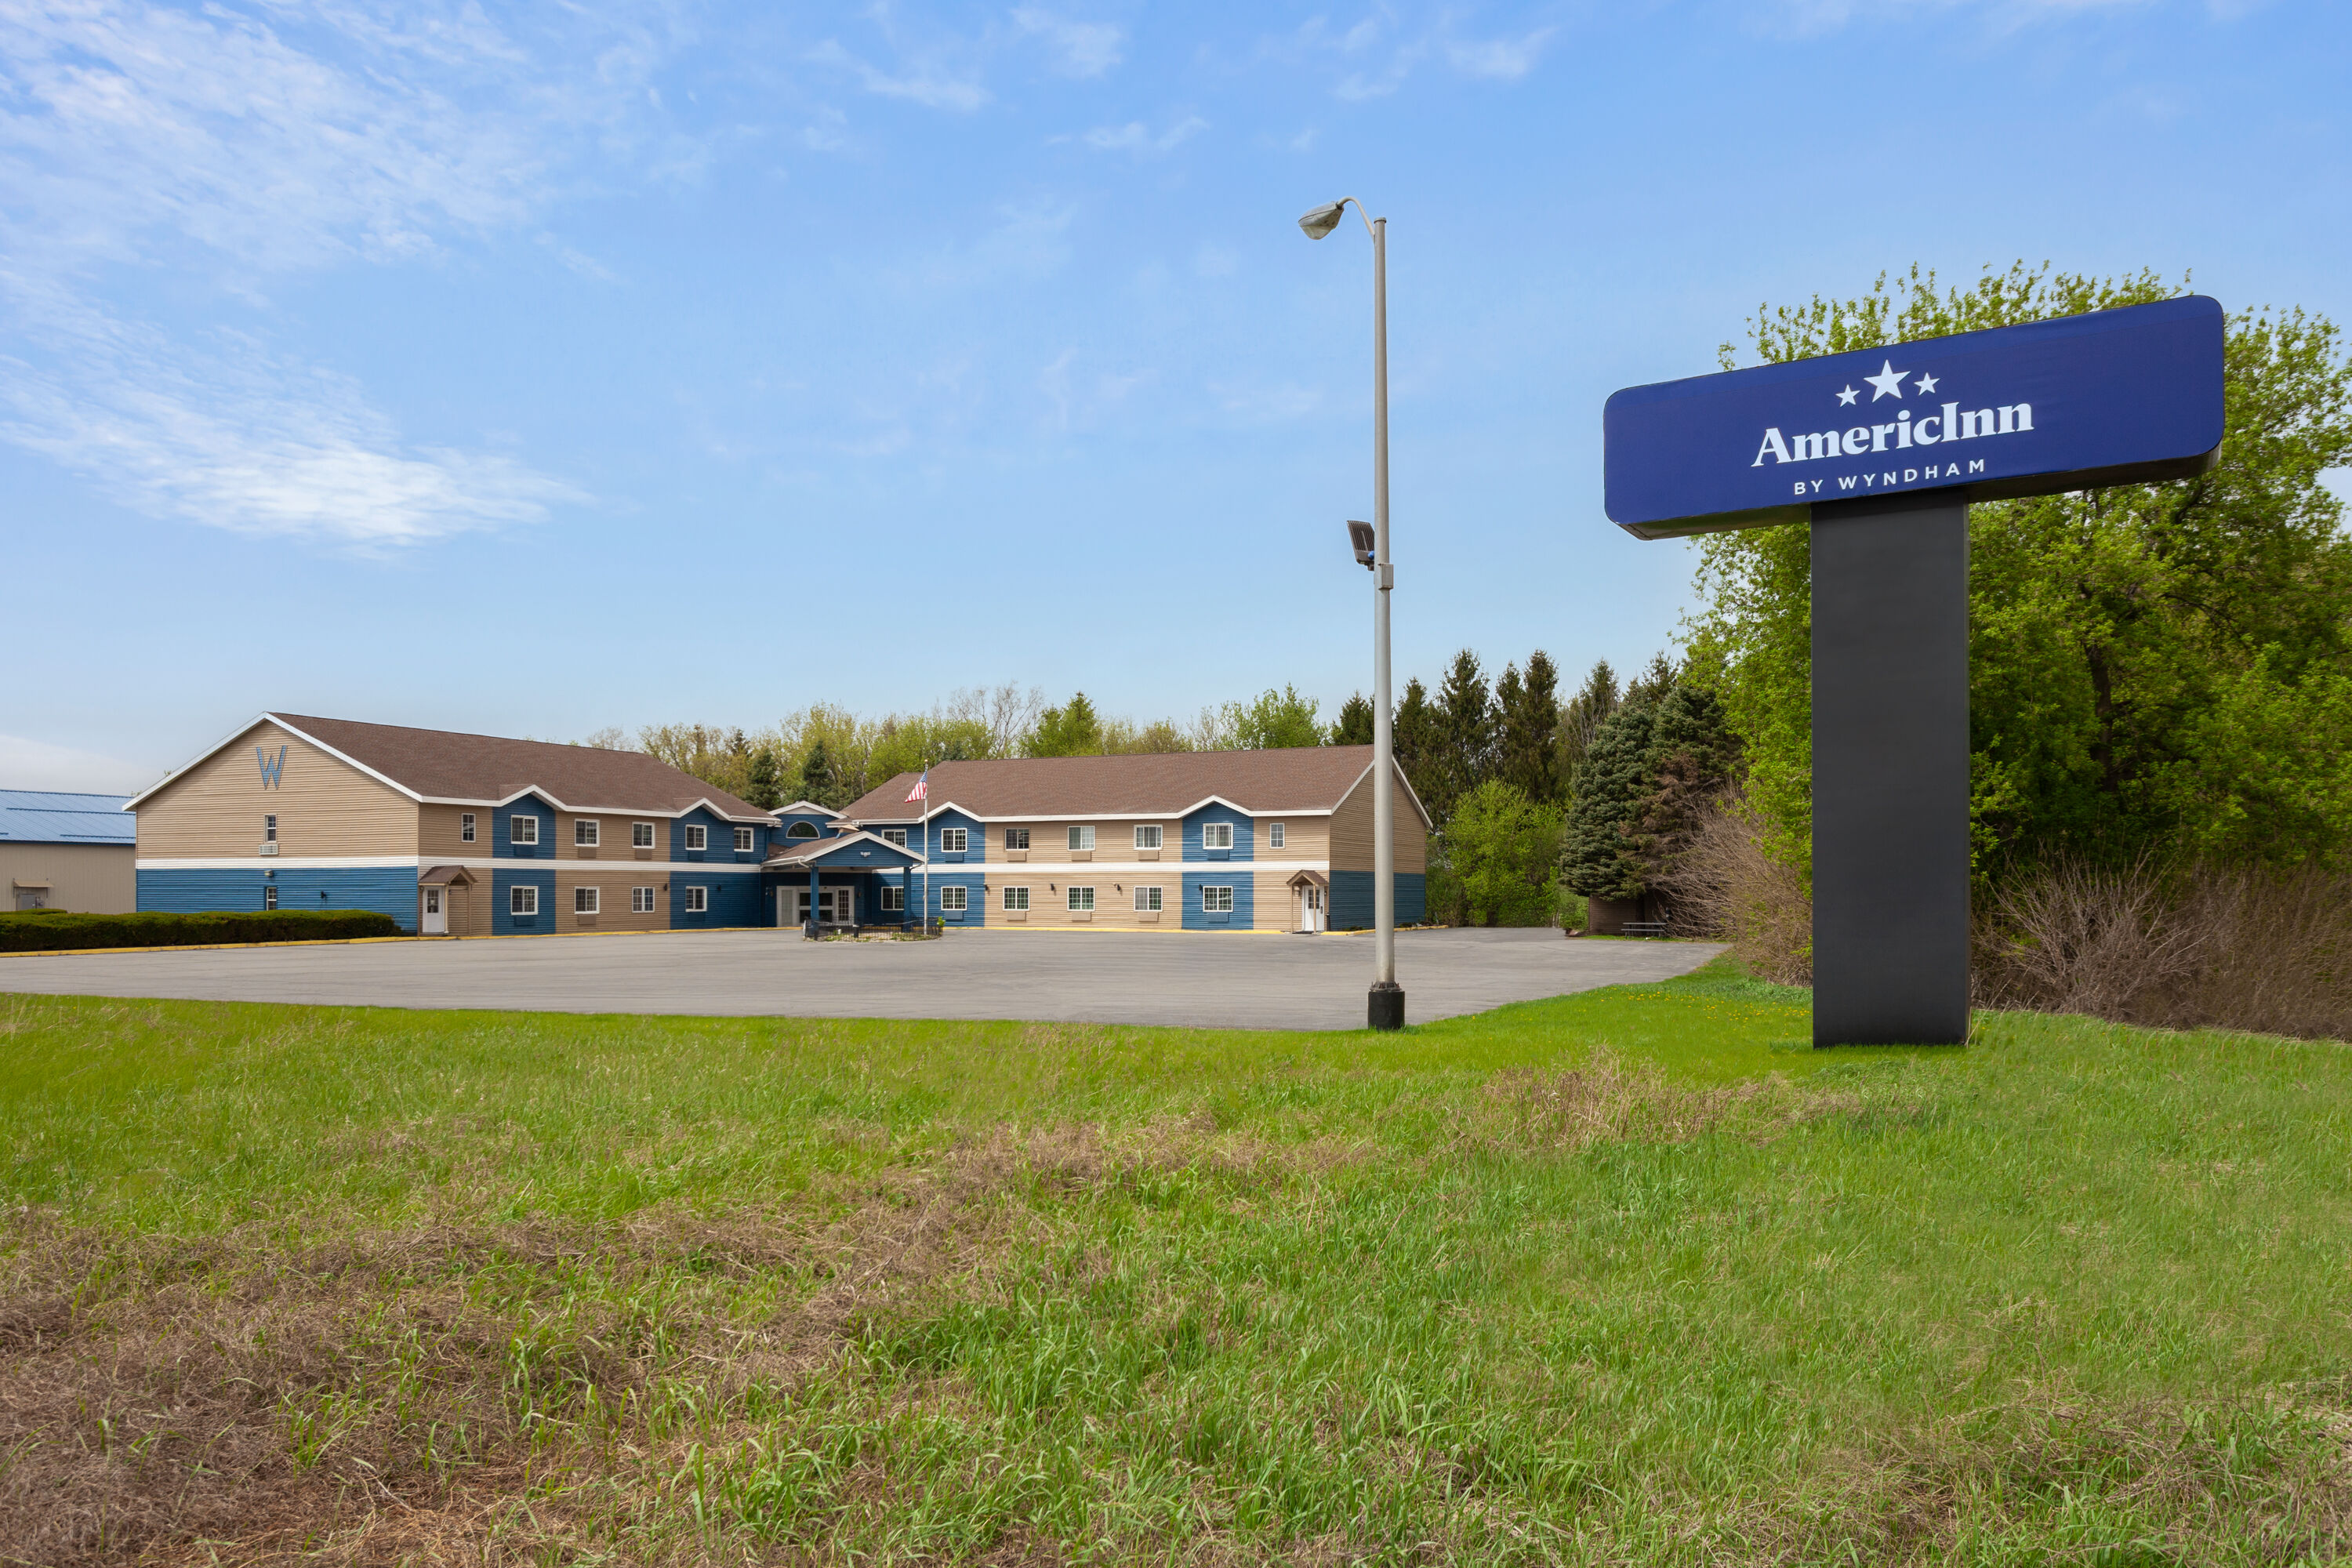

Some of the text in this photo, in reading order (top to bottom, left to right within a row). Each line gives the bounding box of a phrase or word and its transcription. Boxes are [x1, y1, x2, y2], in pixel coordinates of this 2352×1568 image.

[1751, 401, 2034, 467] AmericInn
[1794, 459, 1984, 495] BY WYNDHAM
[256, 745, 288, 790] W
